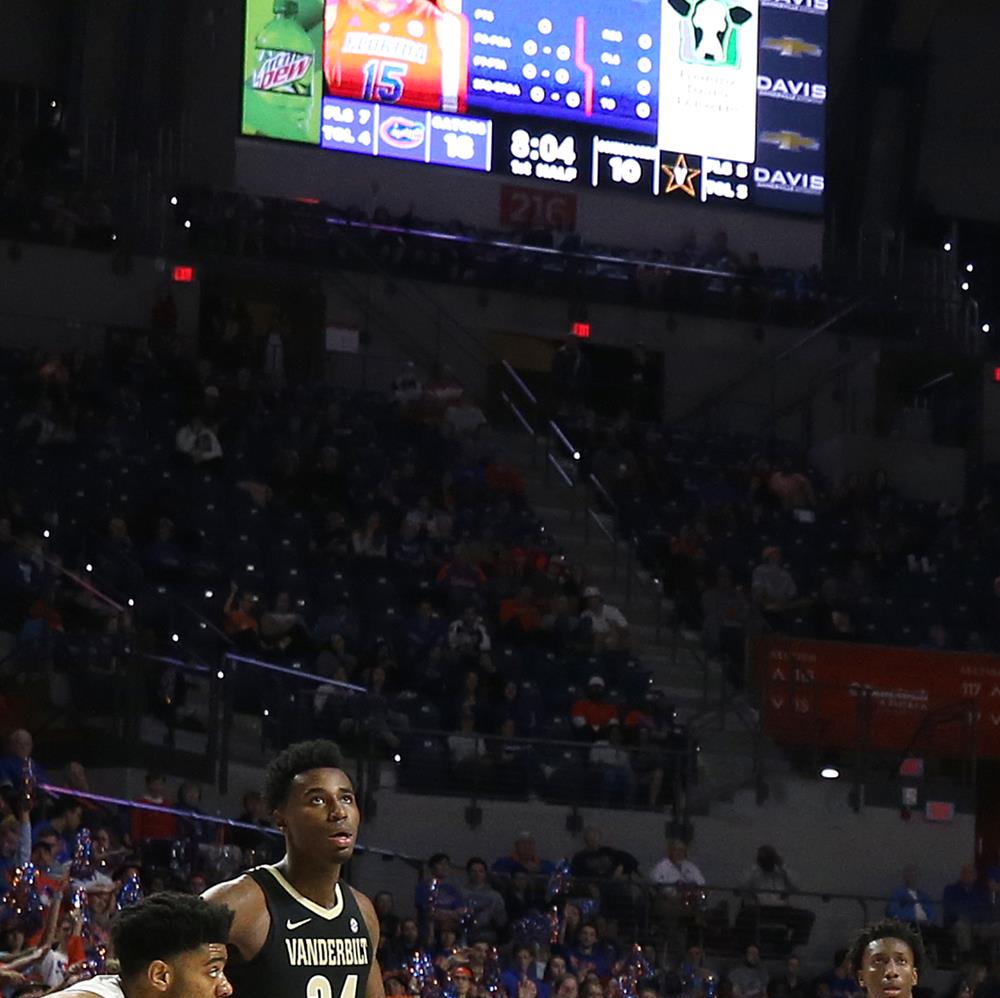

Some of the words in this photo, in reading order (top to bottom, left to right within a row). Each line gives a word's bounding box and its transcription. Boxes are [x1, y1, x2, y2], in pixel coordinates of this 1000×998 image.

[362, 59, 408, 102] 15
[757, 75, 827, 99] DAVIS
[511, 130, 576, 165] 8:04
[609, 157, 641, 183] 10
[754, 168, 825, 190] DAVIS
[285, 938, 369, 967] VANDERBILT
